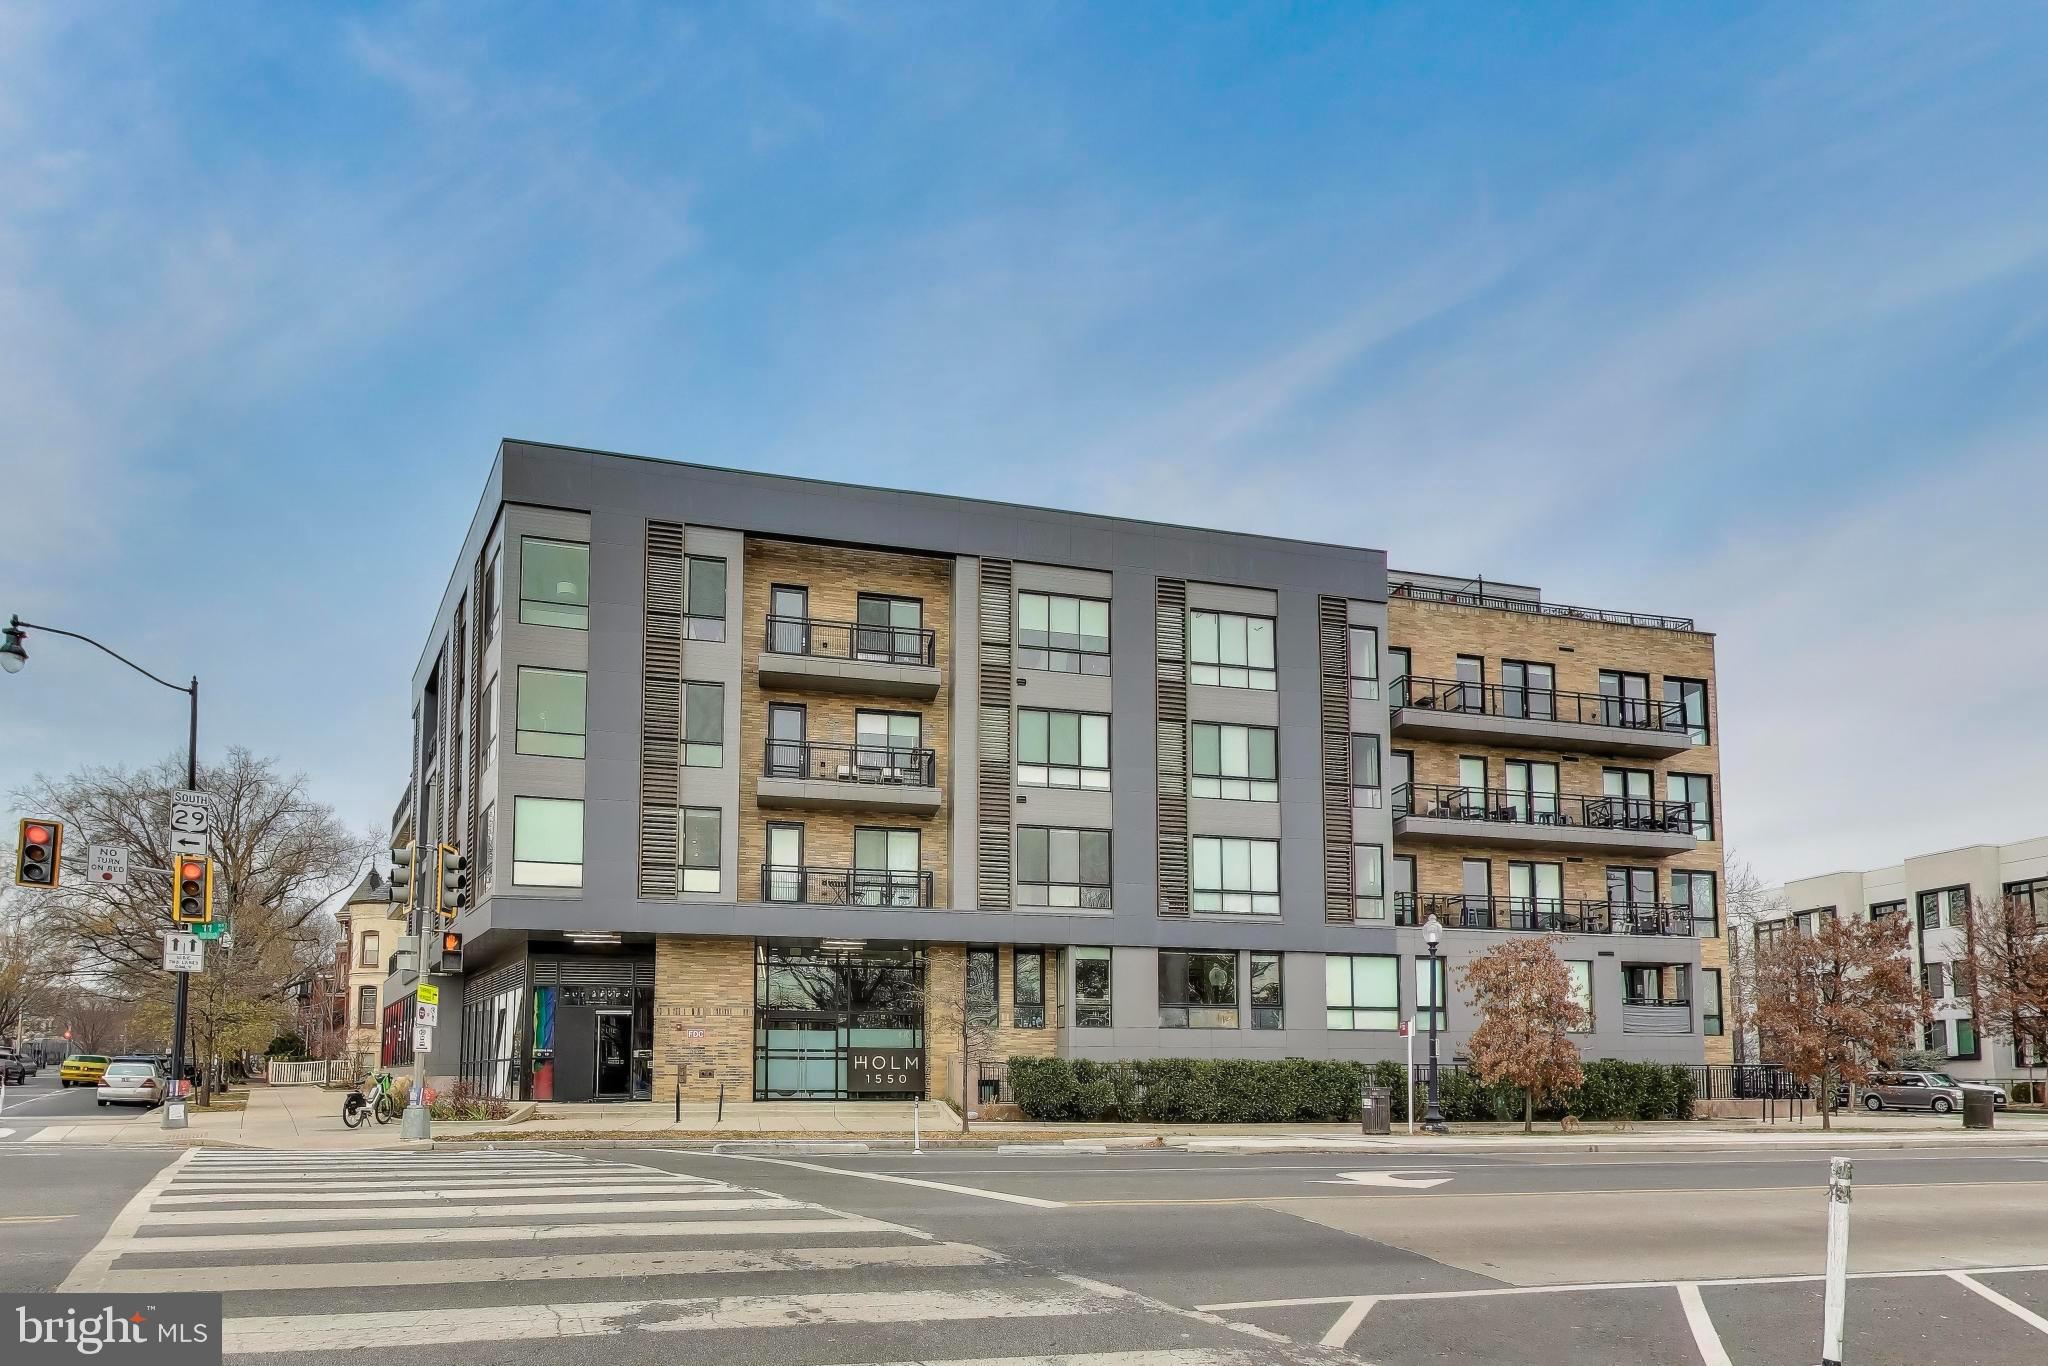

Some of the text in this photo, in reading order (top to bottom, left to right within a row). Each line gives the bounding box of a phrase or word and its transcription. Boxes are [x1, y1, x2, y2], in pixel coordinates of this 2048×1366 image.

[175, 791, 208, 805] SOUTH
[175, 809, 205, 826] 29
[100, 848, 117, 857] NO
[97, 857, 120, 865] TURN
[107, 865, 125, 873] RED
[688, 1030, 704, 1038] FDC
[854, 1055, 919, 1070] HOLM
[865, 1074, 907, 1084] 1550
